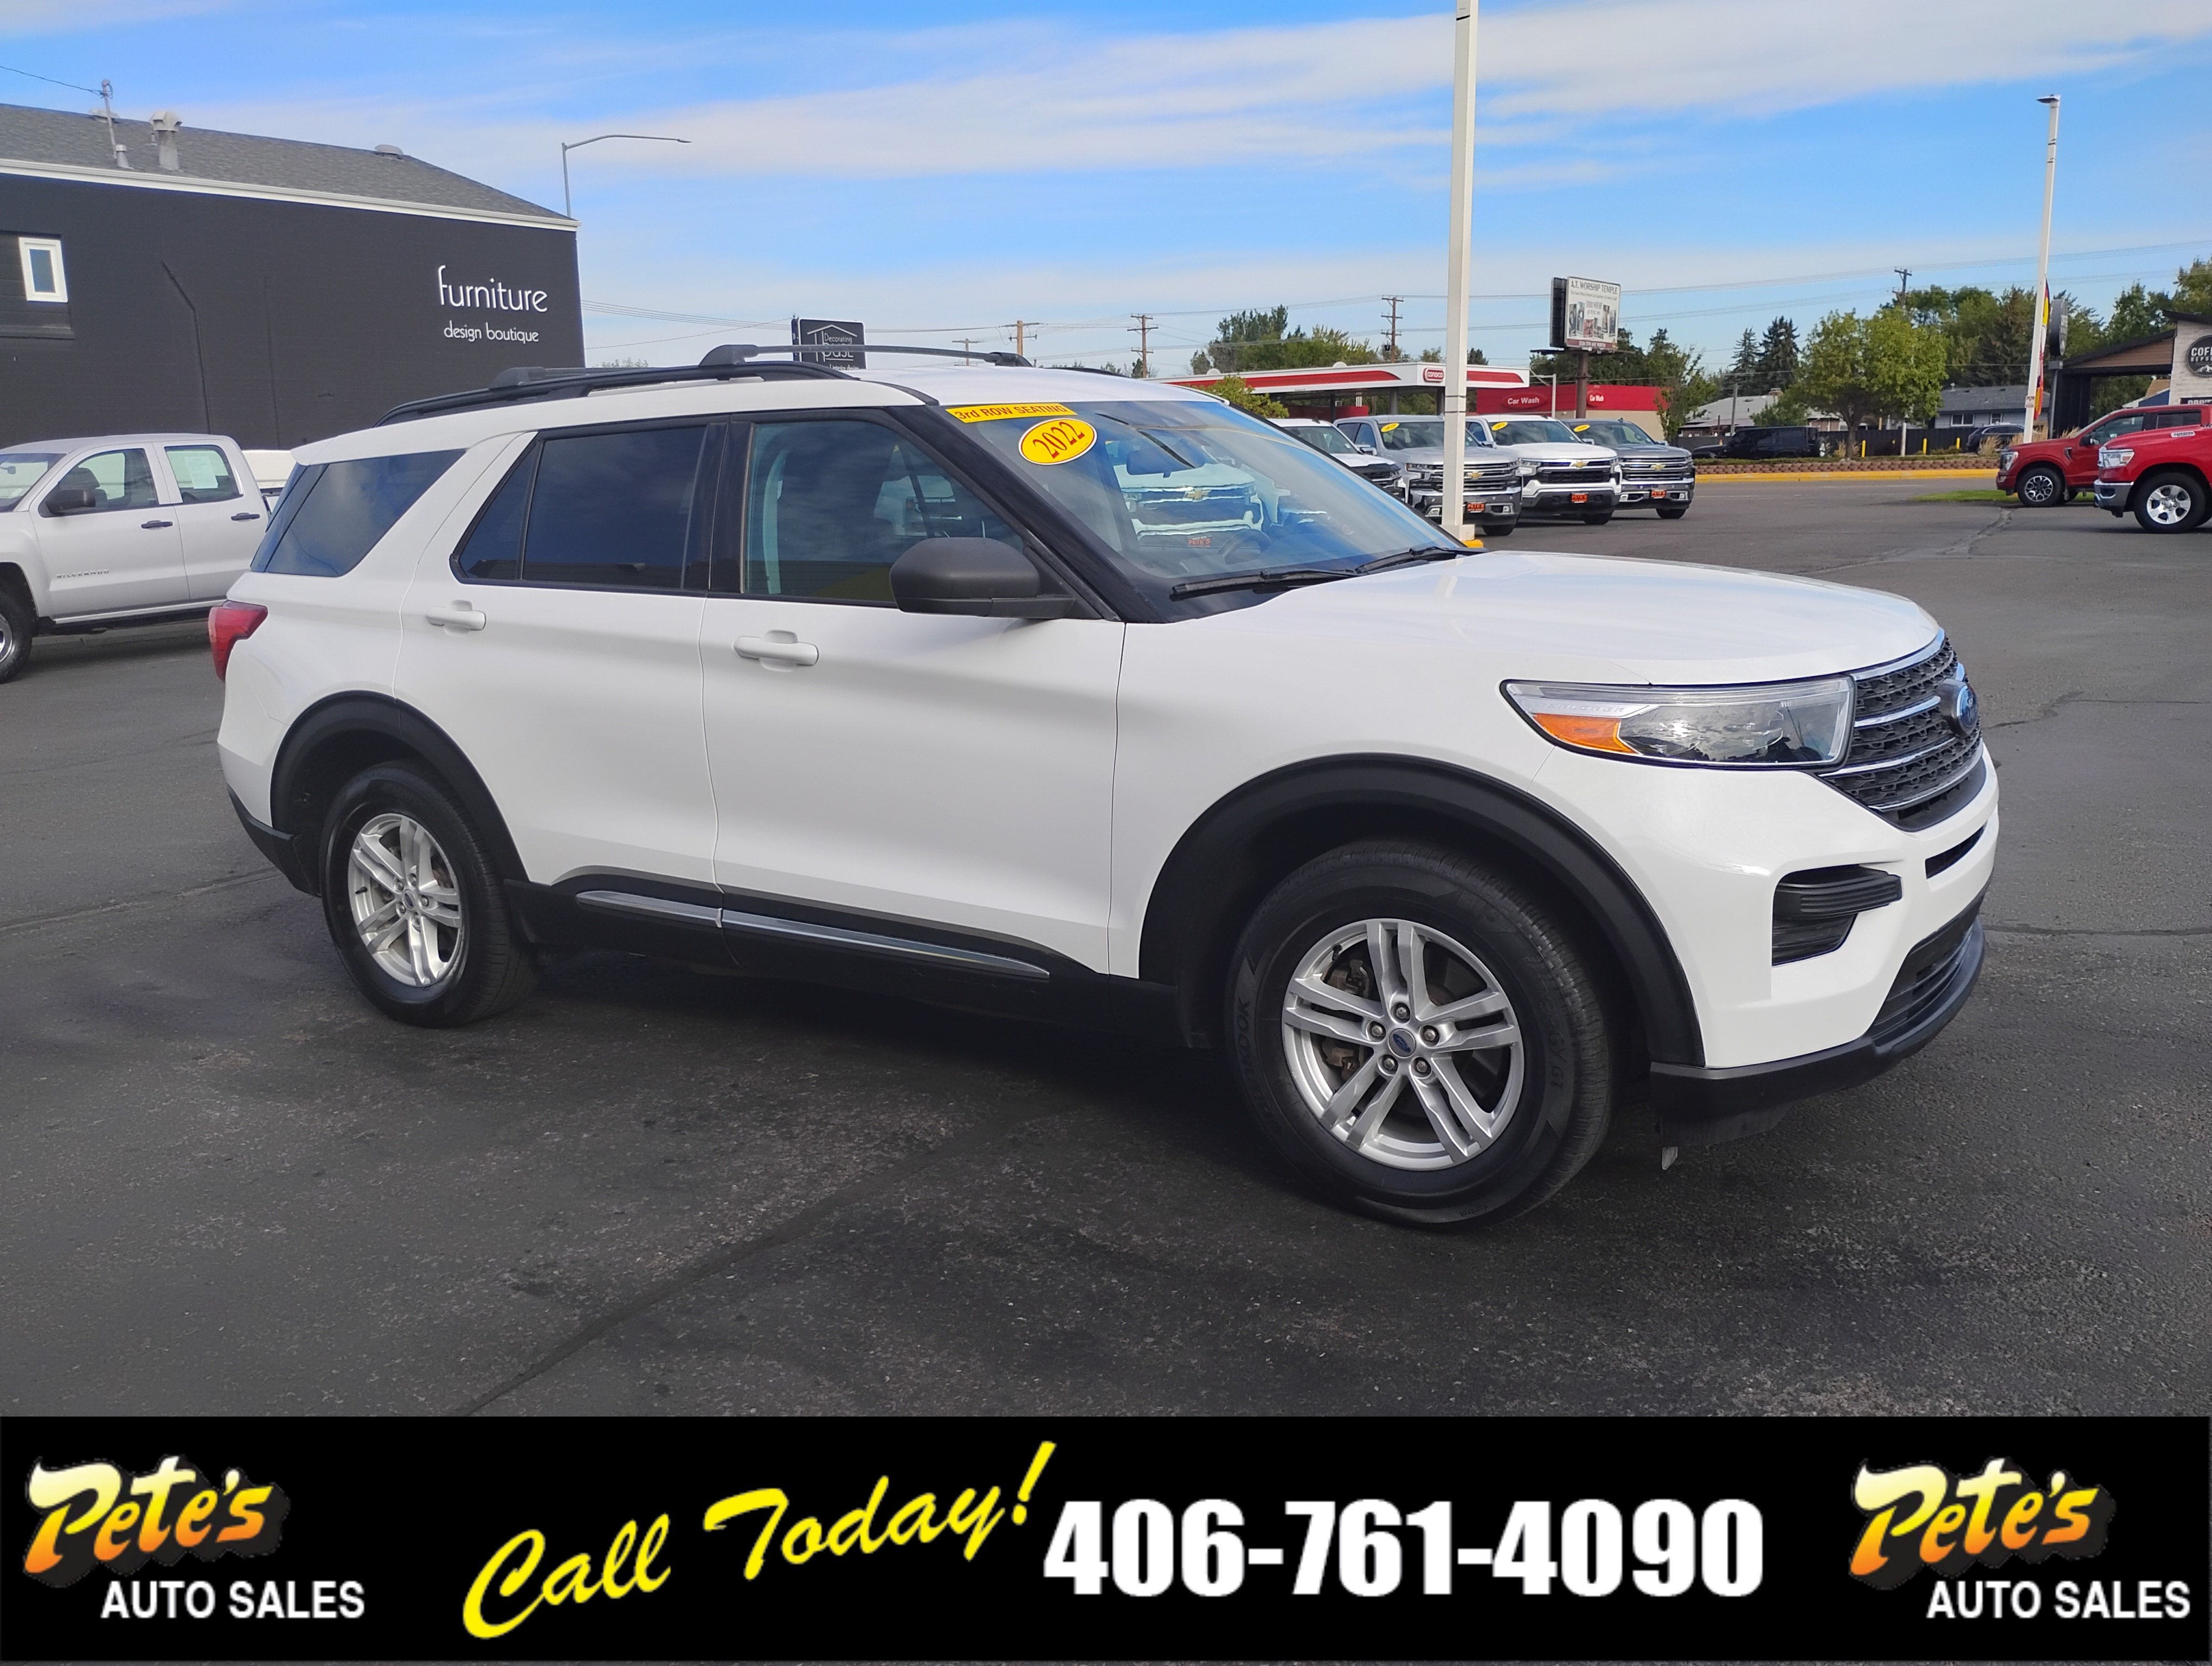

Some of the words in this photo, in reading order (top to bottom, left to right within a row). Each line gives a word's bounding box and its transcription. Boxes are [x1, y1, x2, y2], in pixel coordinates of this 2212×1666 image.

[438, 265, 548, 313] furniture
[1580, 281, 1600, 291] WORSHIP
[1601, 285, 1618, 294] TEMPLE
[443, 319, 482, 343] design
[485, 322, 539, 344] boutique
[824, 332, 853, 344] Decorating
[954, 408, 979, 420] 3rd
[983, 407, 1013, 416] ROW
[1013, 405, 1068, 415] SEATING
[1032, 421, 1085, 459] 2022
[56, 569, 109, 579] SILVERADO
[1537, 703, 1625, 713] EXPLORER
